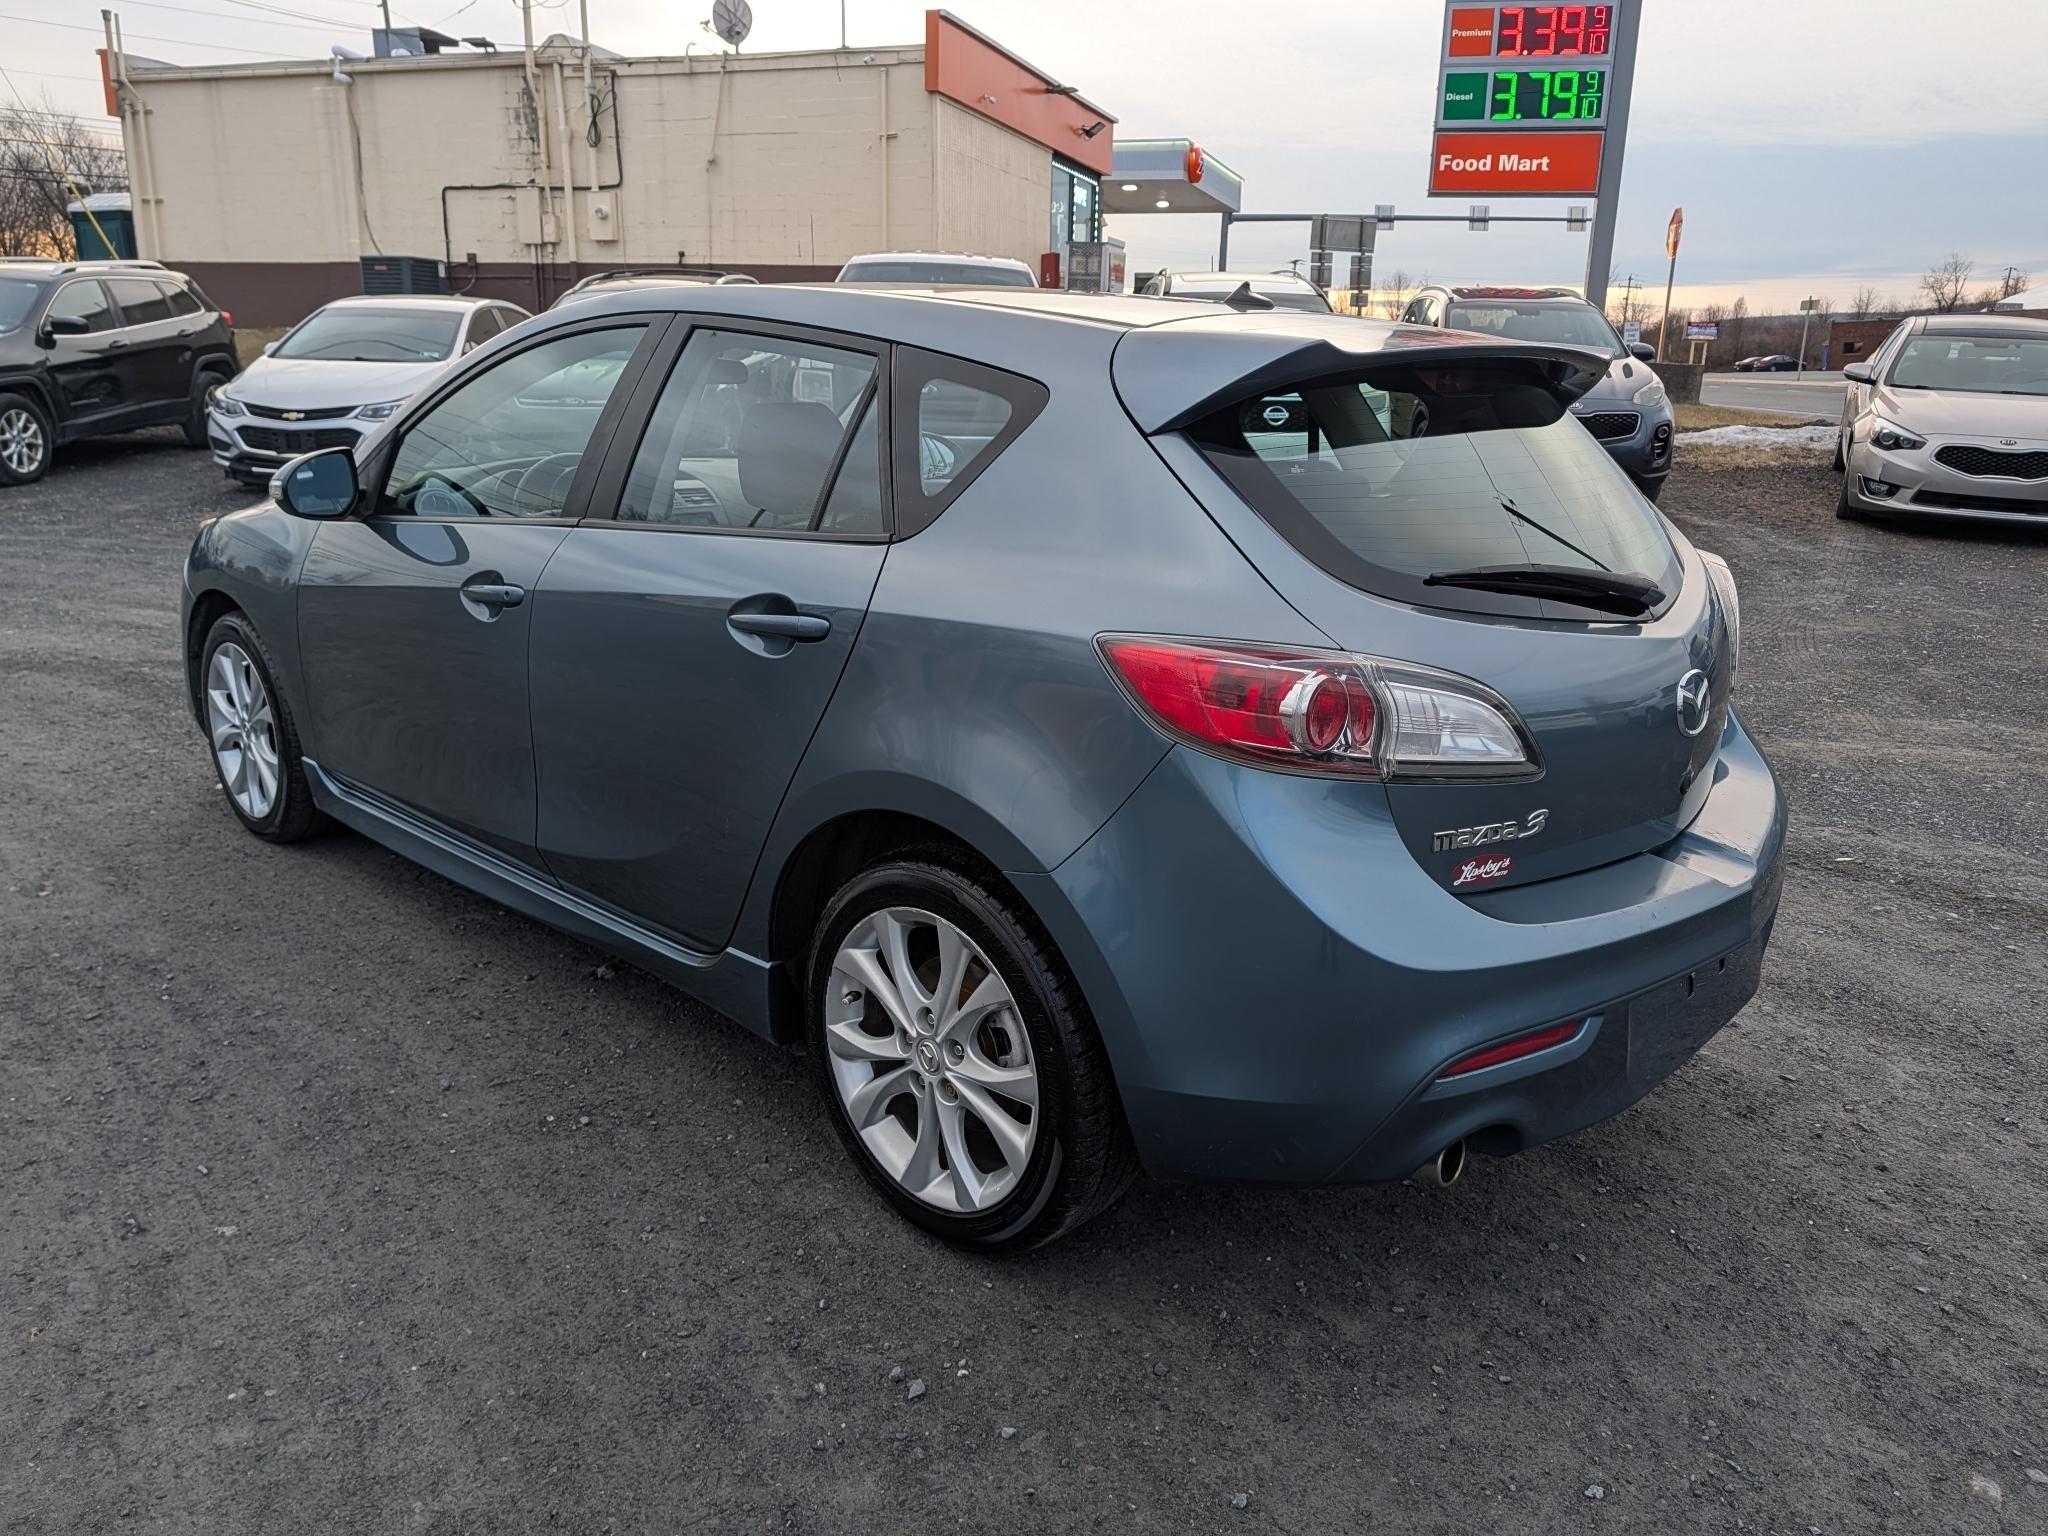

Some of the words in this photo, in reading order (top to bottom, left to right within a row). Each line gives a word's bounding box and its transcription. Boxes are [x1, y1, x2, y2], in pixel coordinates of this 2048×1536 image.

[1451, 29, 1492, 37] Premium
[1498, 6, 1586, 56] 3.39
[1446, 92, 1473, 101] Diesel
[1491, 72, 1579, 120] 3.79
[1439, 154, 1492, 172] Food
[1498, 155, 1550, 172] Mart
